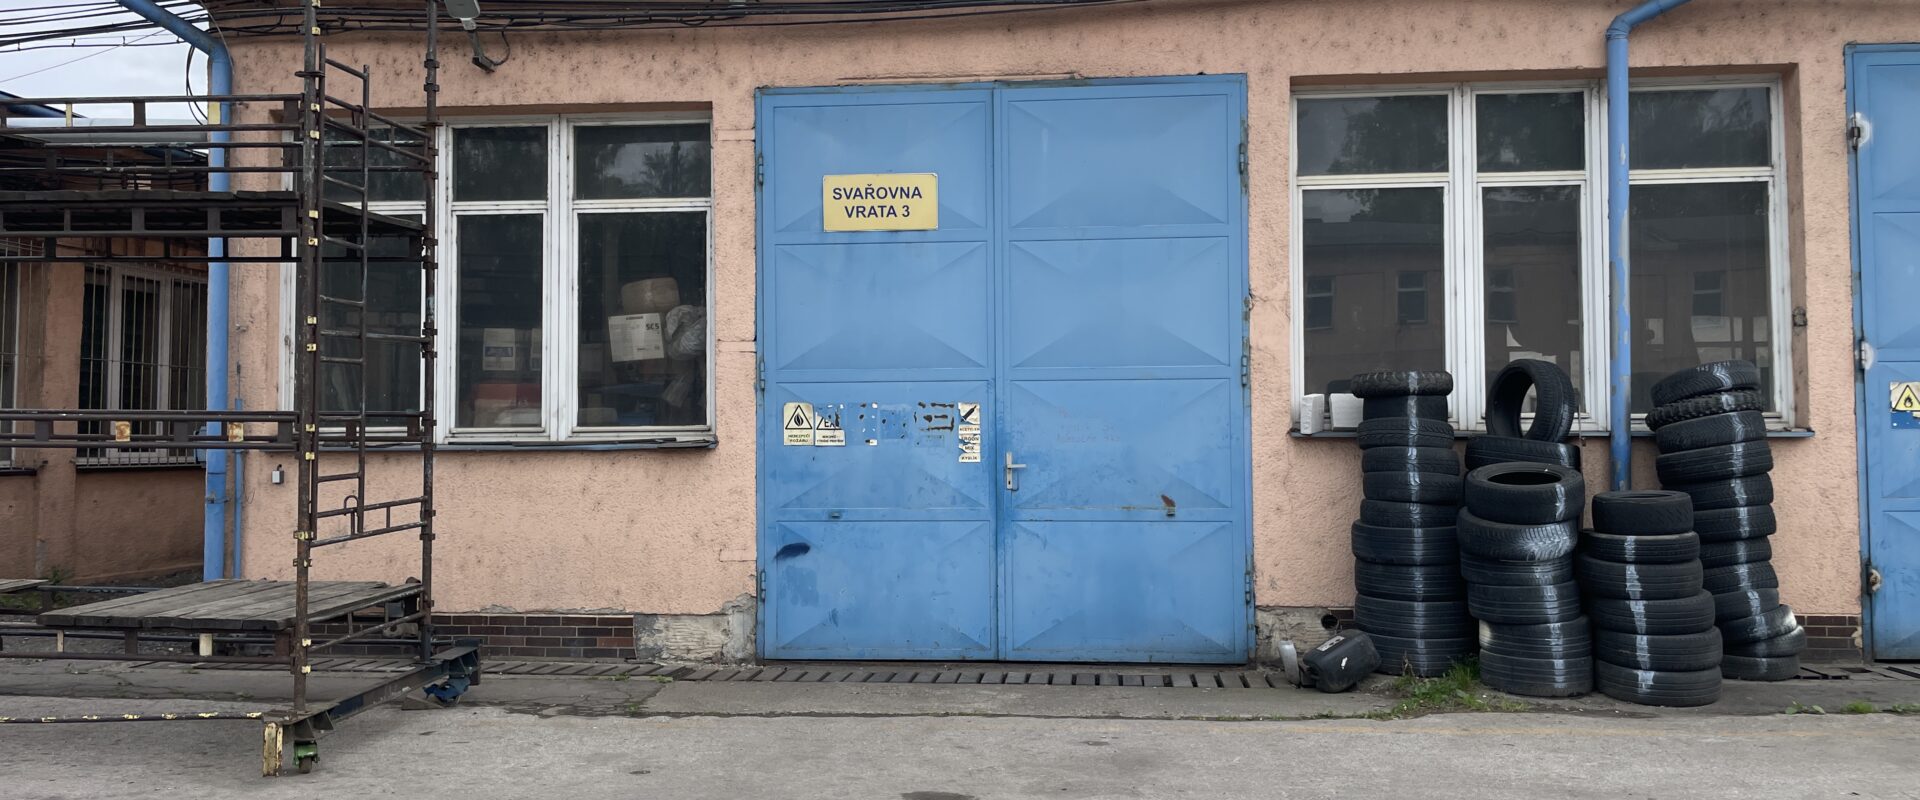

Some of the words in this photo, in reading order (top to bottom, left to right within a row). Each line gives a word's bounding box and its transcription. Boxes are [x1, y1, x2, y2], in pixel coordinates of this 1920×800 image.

[833, 184, 922, 200] SVAŘOVNA
[845, 205, 897, 218] VRATA
[902, 205, 910, 217] 3
